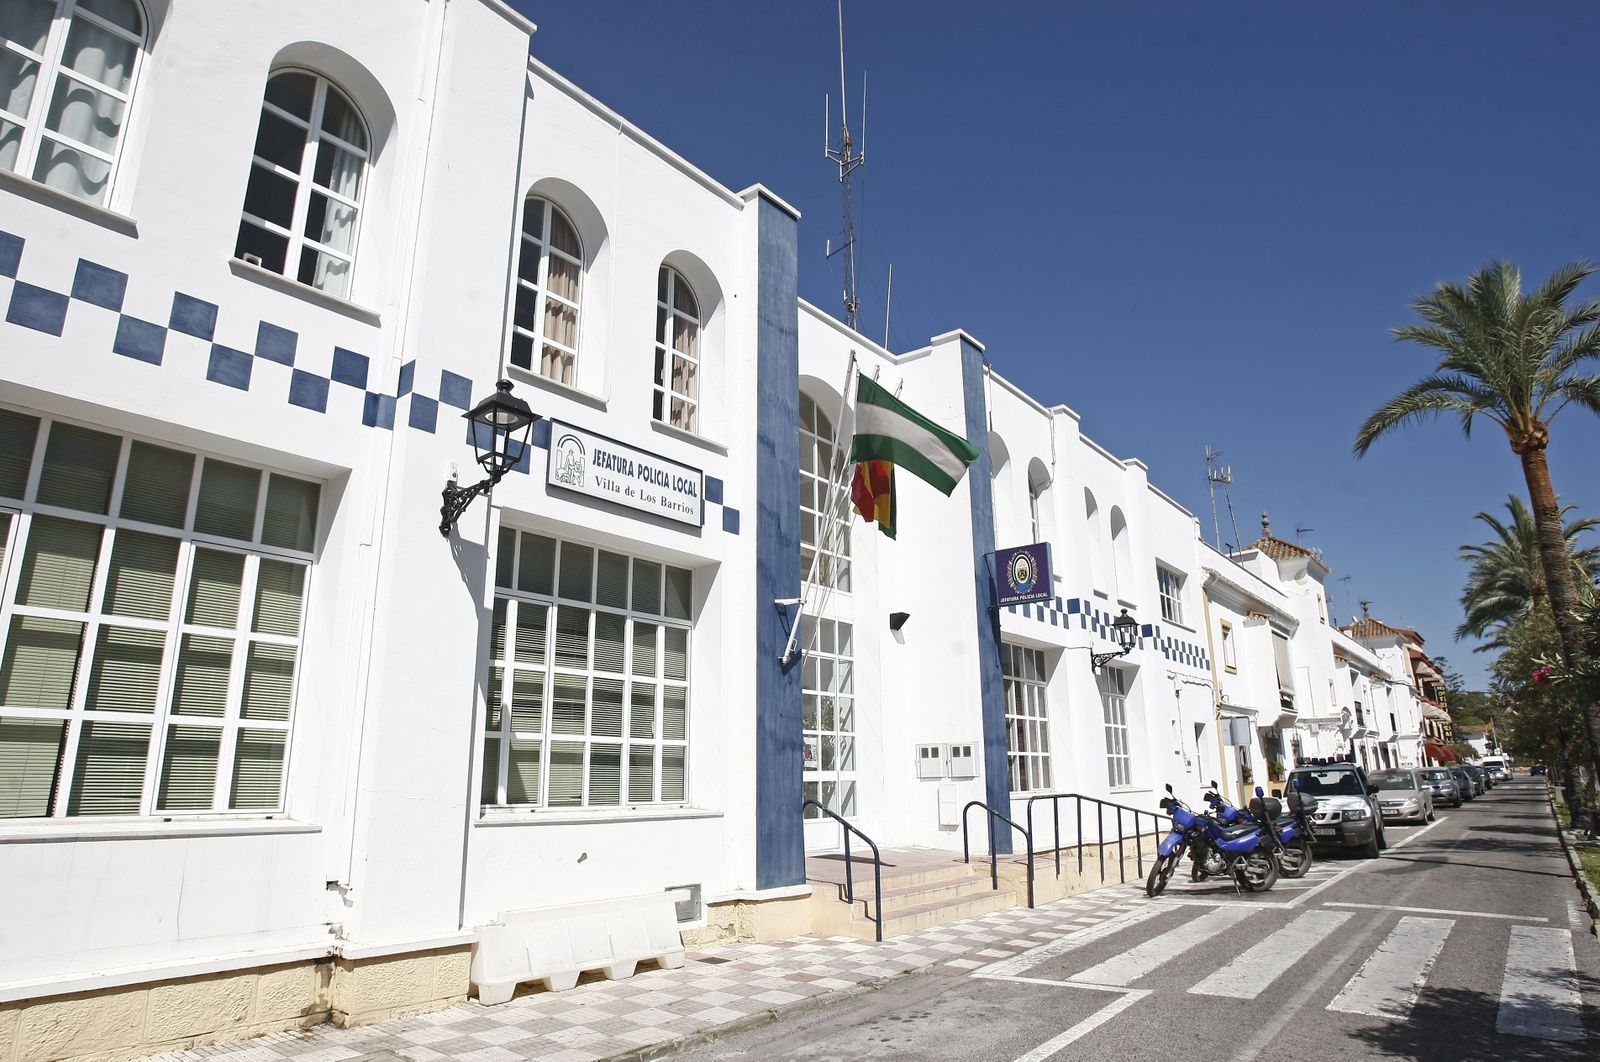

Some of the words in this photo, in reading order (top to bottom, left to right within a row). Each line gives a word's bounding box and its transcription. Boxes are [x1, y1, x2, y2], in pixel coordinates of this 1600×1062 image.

[592, 448, 634, 478] JEFATURA
[637, 463, 670, 489] POLICIA
[672, 474, 697, 498] LOCAL
[595, 475, 621, 494] Villa
[624, 485, 636, 498] de
[639, 489, 657, 504] Los
[660, 495, 694, 515] Barrios
